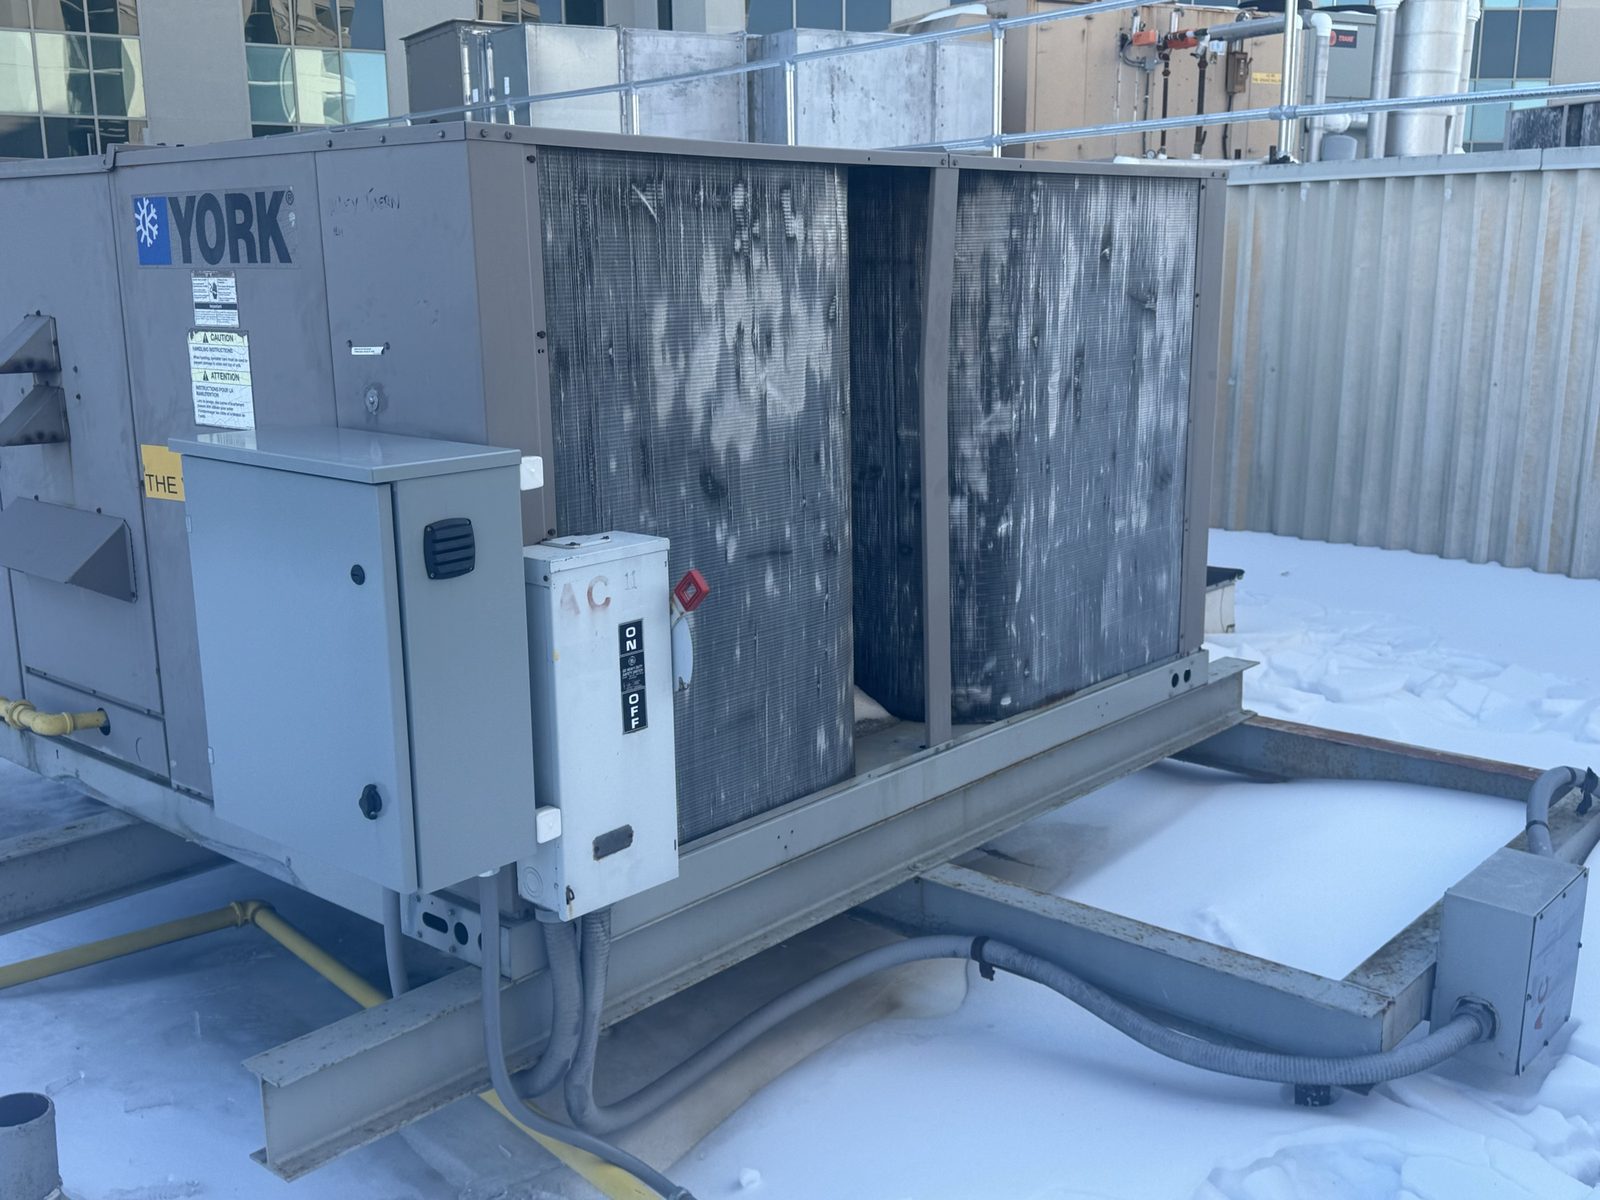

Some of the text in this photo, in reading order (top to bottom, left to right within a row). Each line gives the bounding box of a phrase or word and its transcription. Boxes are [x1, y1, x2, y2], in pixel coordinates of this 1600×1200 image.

[168, 190, 293, 265] YORK
[210, 333, 234, 342] CAUTION
[211, 371, 240, 381] ATTENTION
[145, 473, 178, 494] THE
[626, 626, 637, 651] ON
[629, 693, 640, 729] OFF
